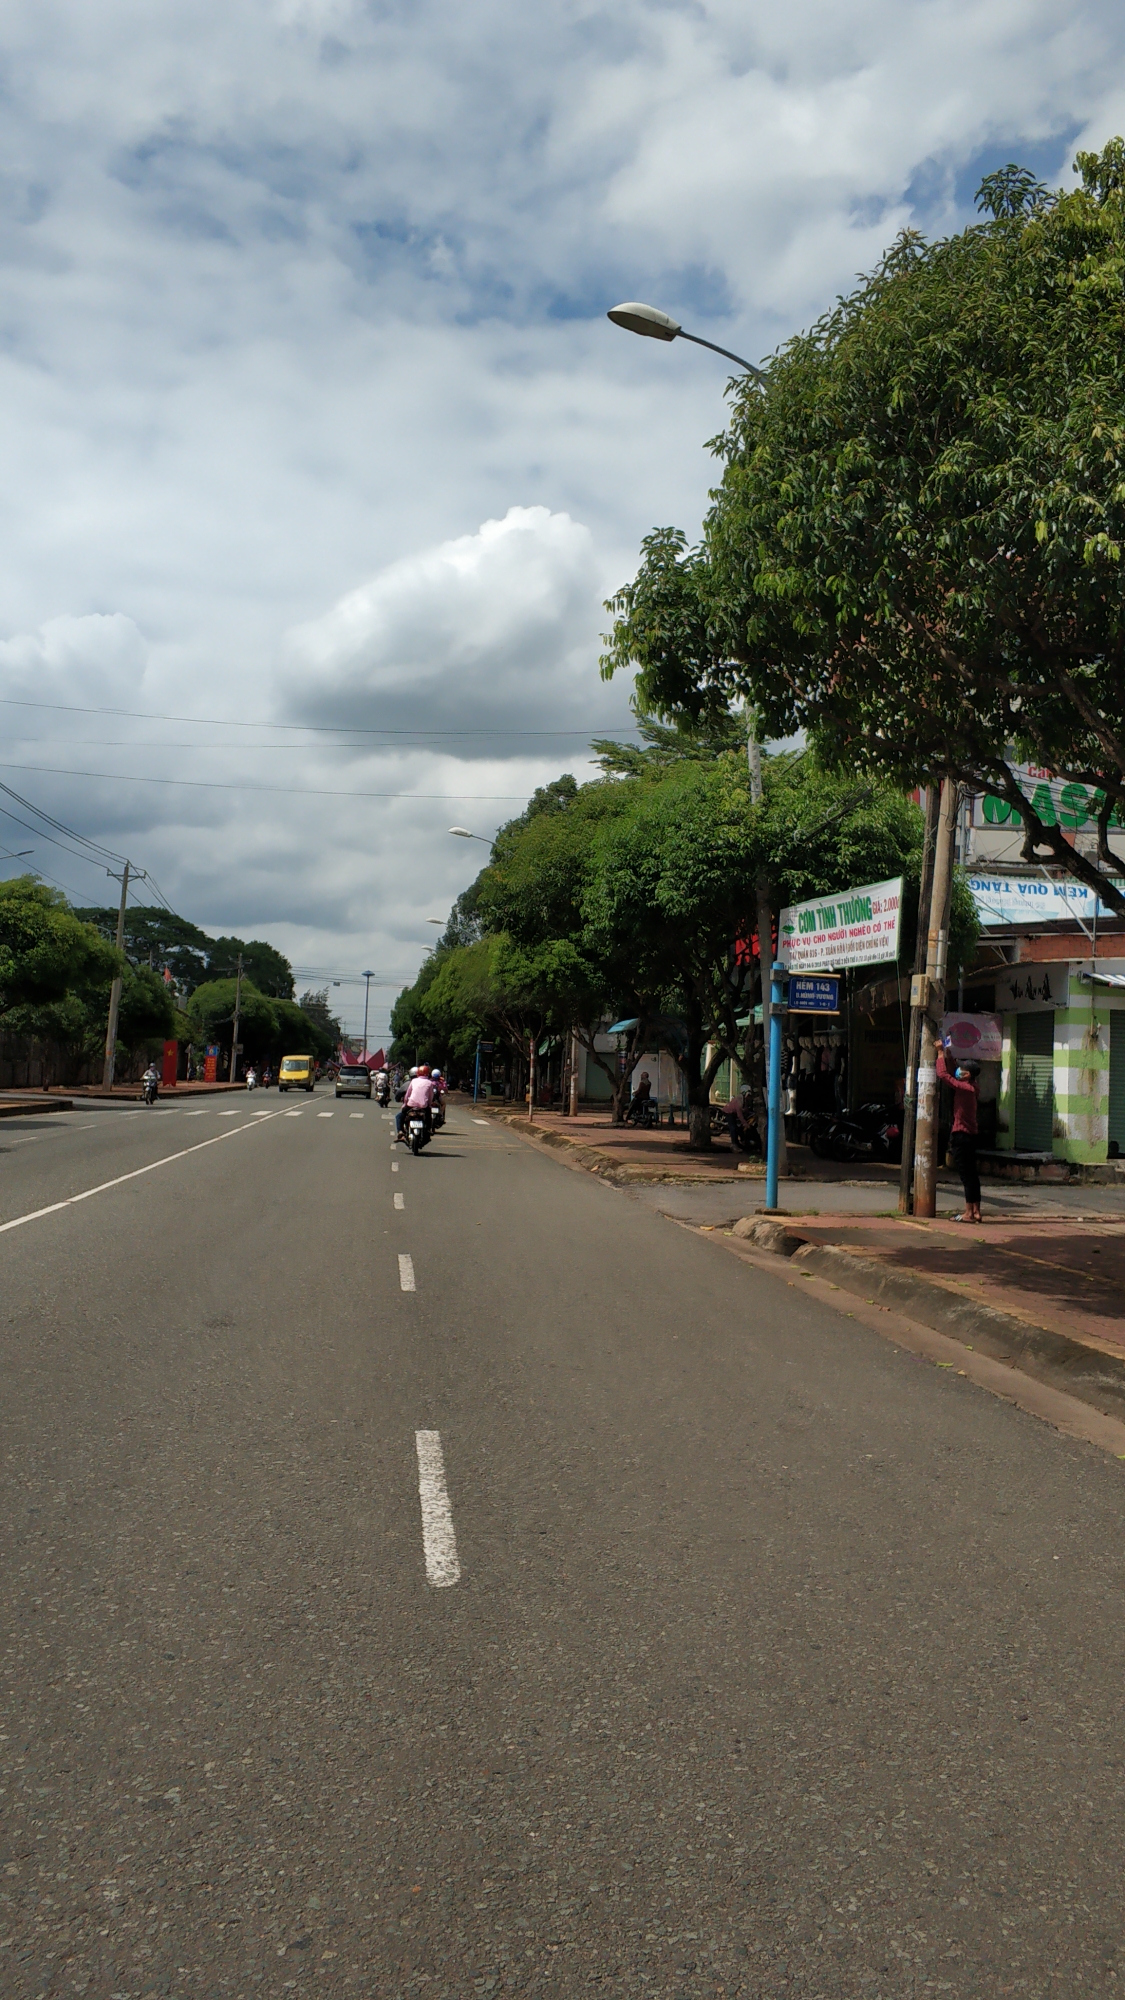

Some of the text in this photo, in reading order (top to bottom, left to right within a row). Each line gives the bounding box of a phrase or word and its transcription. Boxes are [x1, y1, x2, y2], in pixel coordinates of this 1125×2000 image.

[969, 879, 1012, 895] TẶNG
[1017, 883, 1048, 897] QUÀ
[798, 908, 816, 934] CƠM
[816, 903, 837, 930] TÌNH
[837, 895, 873, 927] THƯƠNG
[782, 938, 801, 949] PHỤC
[802, 937, 811, 946] VỤ
[813, 934, 826, 944] CHO
[828, 928, 848, 941] NGƯỜI
[849, 923, 871, 937] NGHÈO
[872, 920, 882, 933] CÓ
[816, 982, 831, 992] 143
